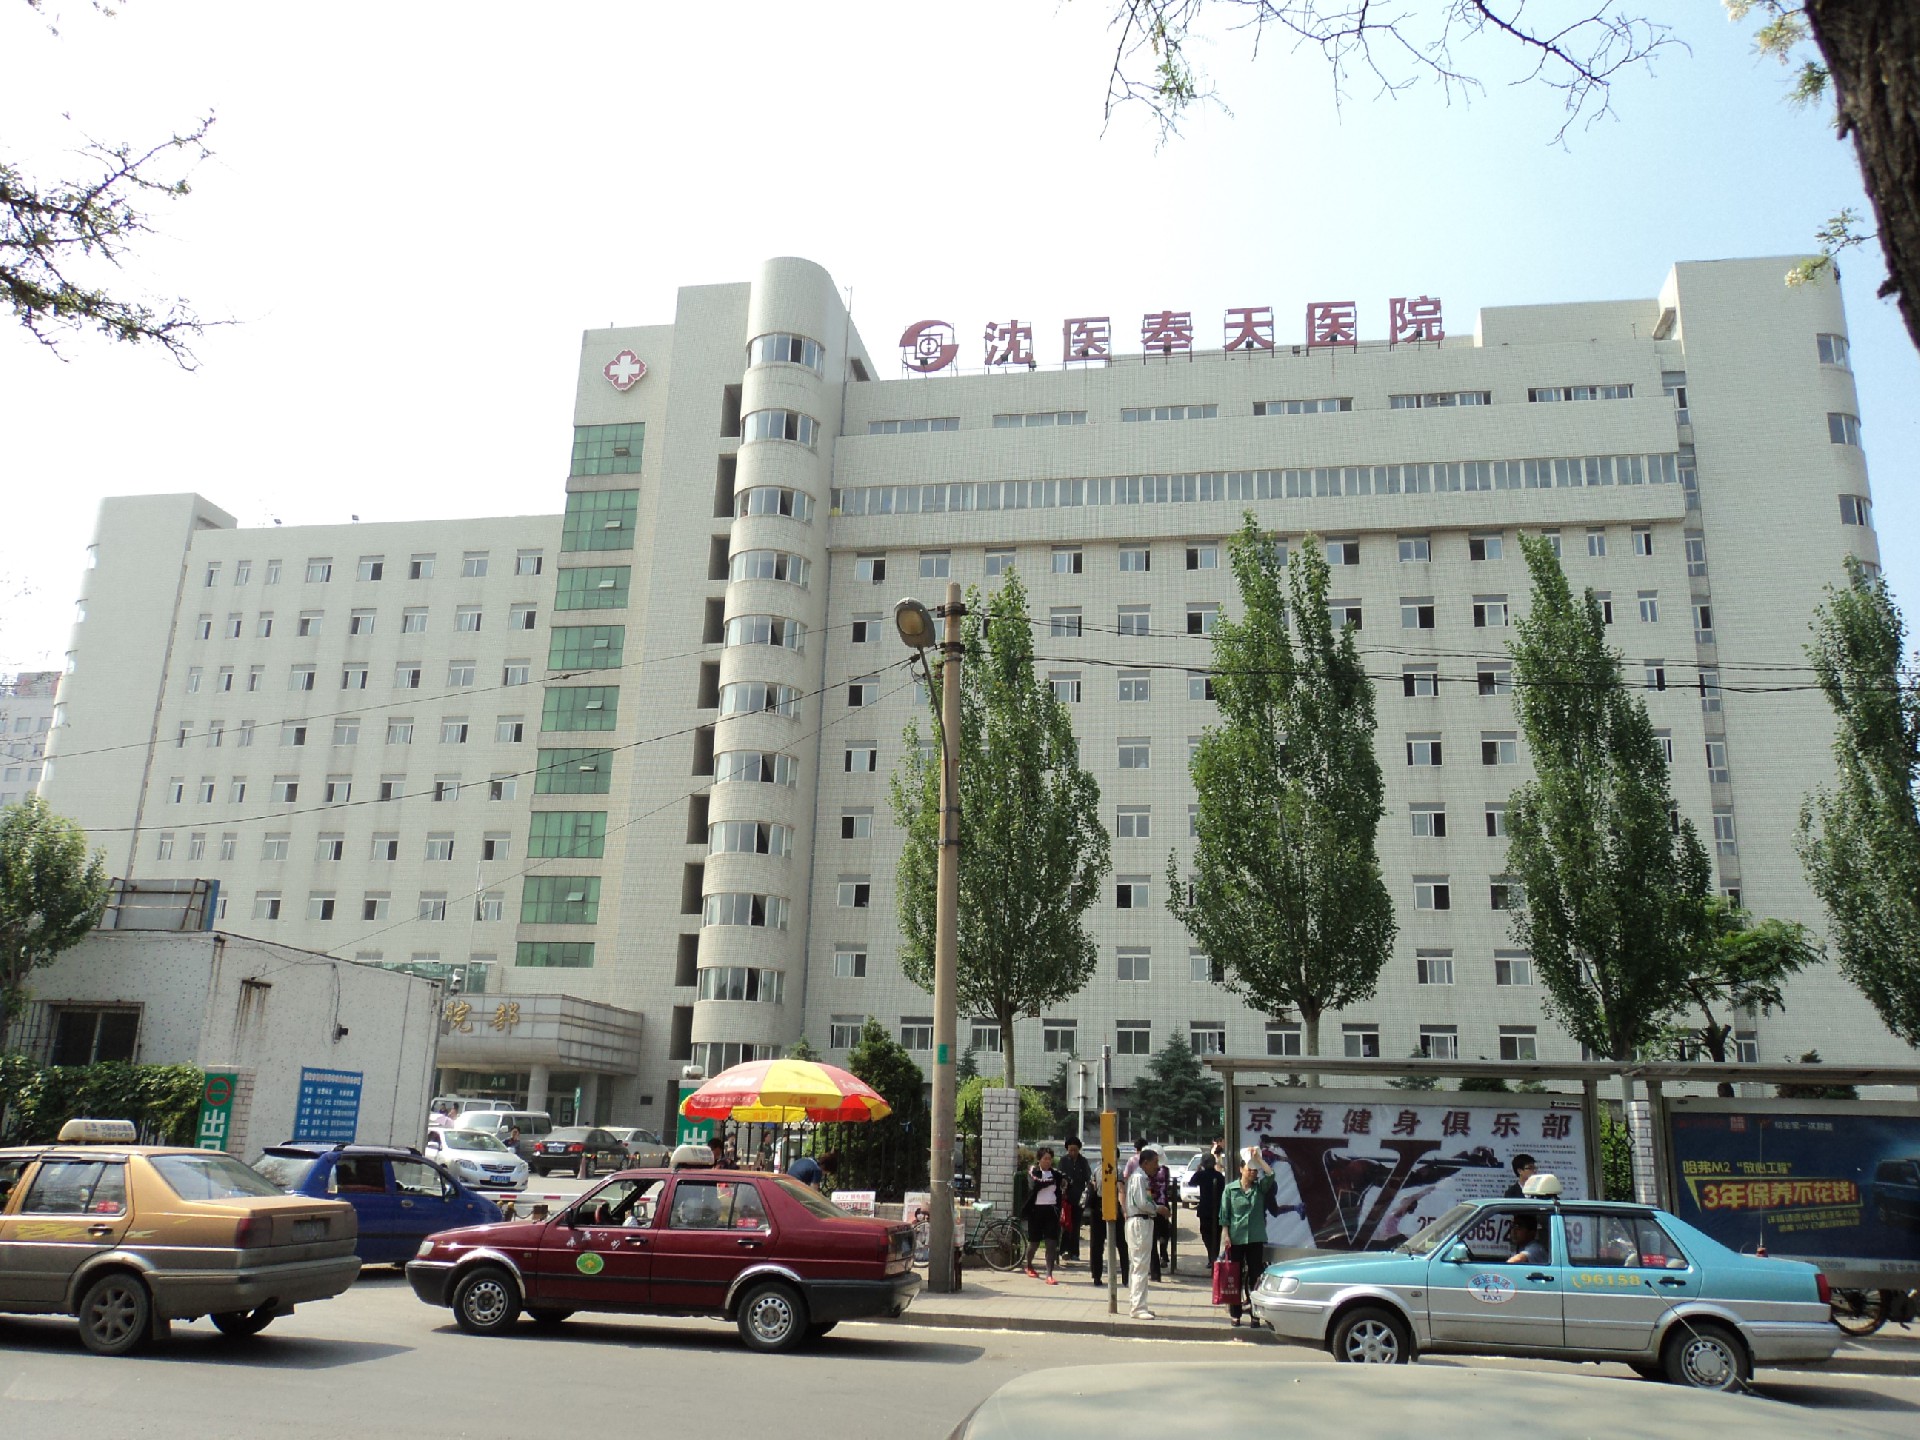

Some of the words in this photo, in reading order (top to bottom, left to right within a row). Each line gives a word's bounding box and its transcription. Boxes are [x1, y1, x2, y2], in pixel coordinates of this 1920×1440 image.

[984, 295, 1445, 365] 沈医奉天医院
[1246, 1107, 1573, 1140] 京海健身俱乐部
[1581, 1273, 1642, 1287] 96158
[1481, 1294, 1503, 1302] TAXI
